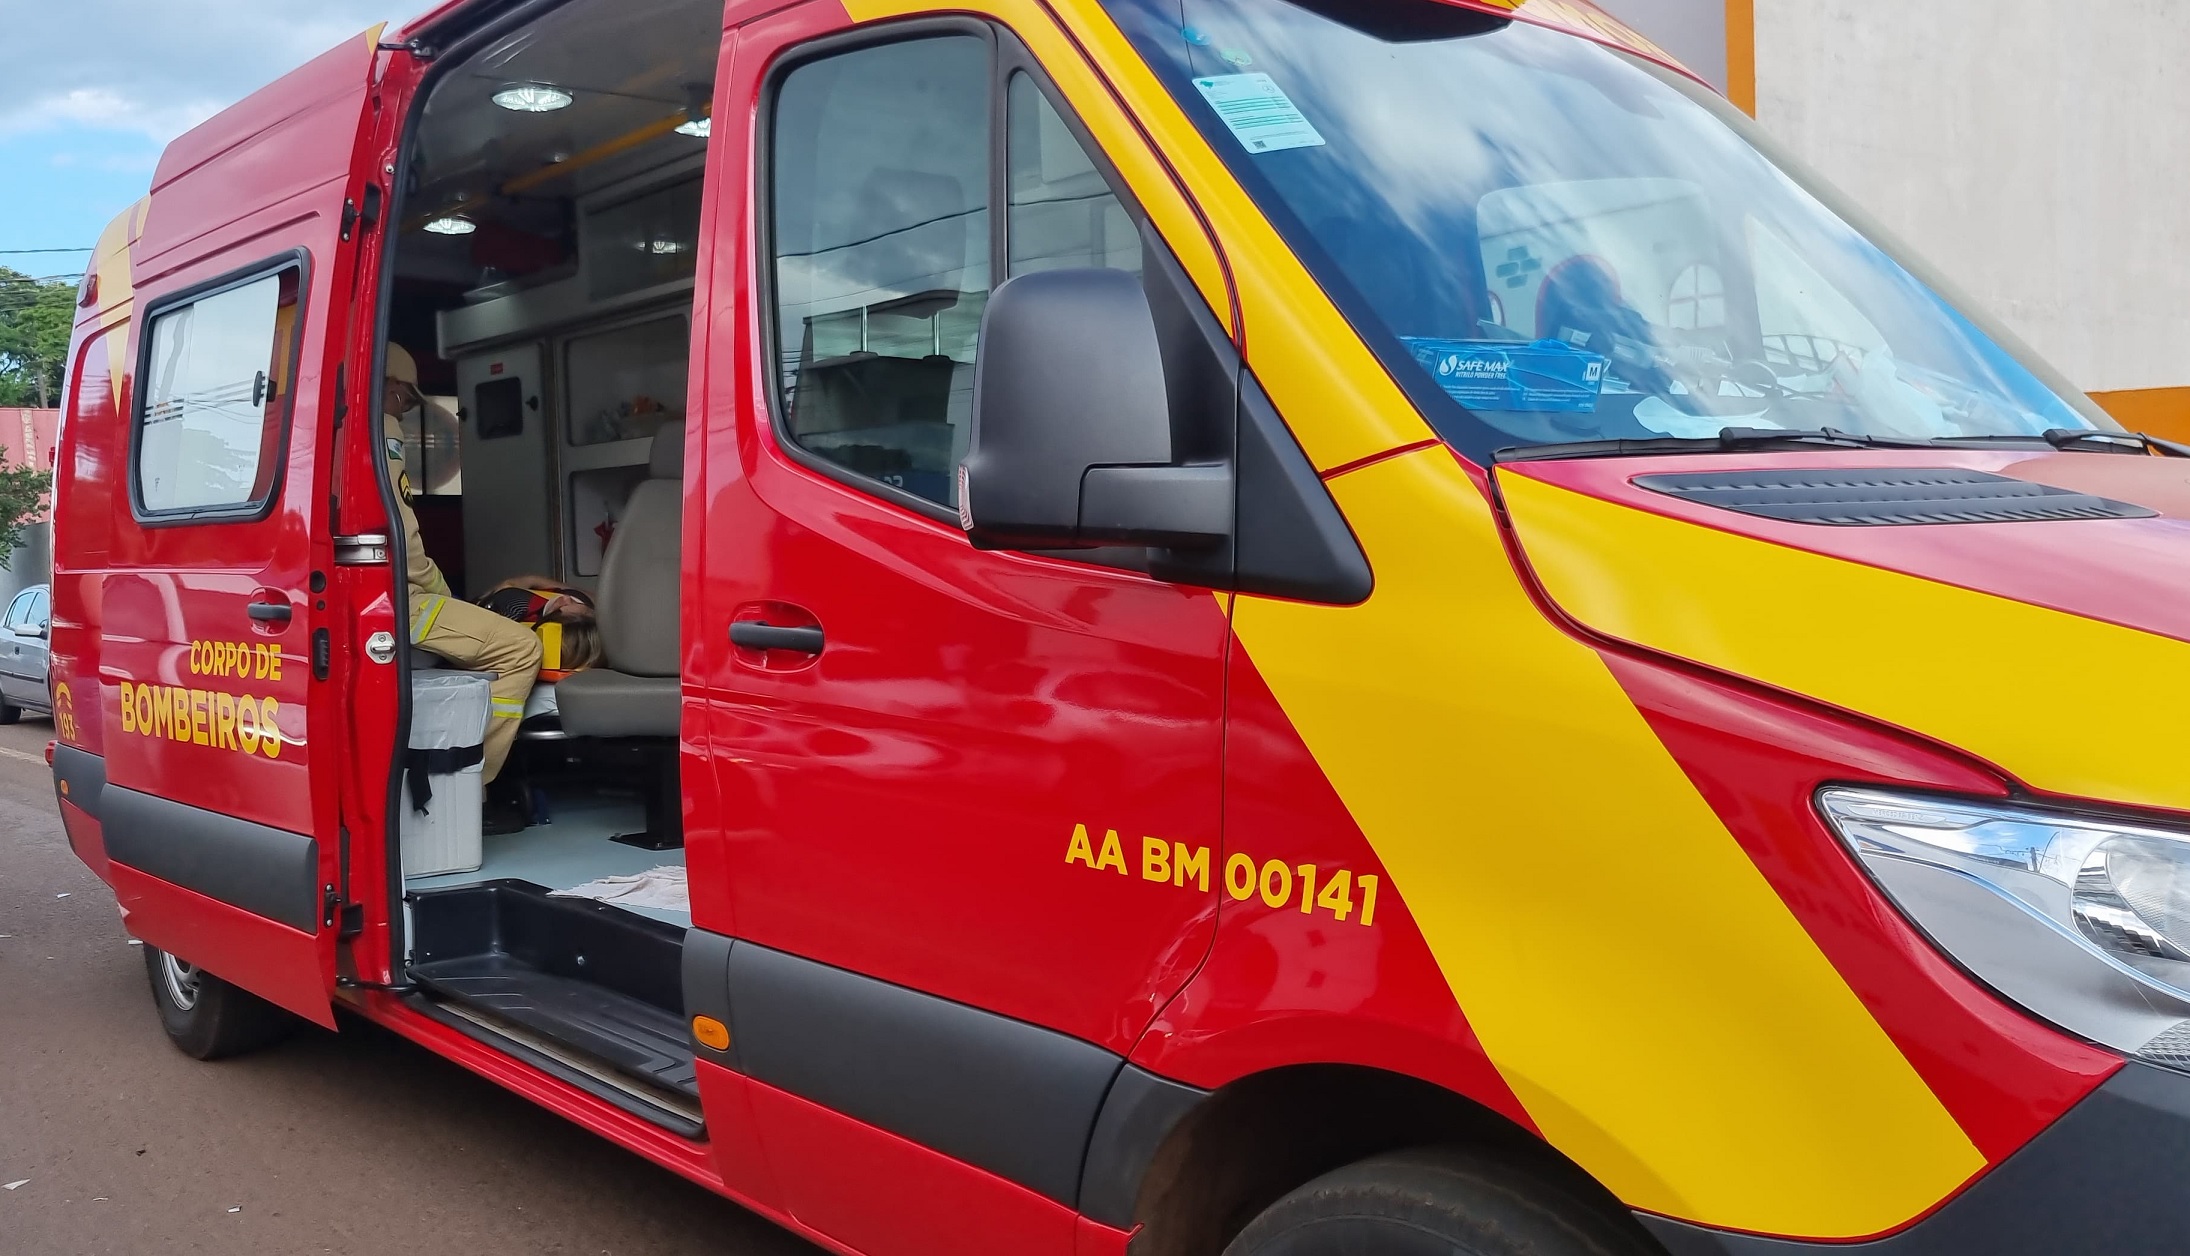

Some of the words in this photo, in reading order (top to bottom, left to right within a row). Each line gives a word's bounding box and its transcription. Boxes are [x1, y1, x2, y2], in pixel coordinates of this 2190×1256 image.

[1456, 360, 1483, 371] SAFE
[1484, 361, 1508, 372] MAX
[1589, 366, 1598, 377] M
[191, 640, 251, 678] CORPO
[255, 643, 282, 681] DE
[58, 712, 76, 741] 193
[120, 681, 281, 758] BOMBEIROS
[1065, 823, 1128, 875] AA
[1142, 836, 1210, 893] BM
[1225, 852, 1379, 927] 00141
